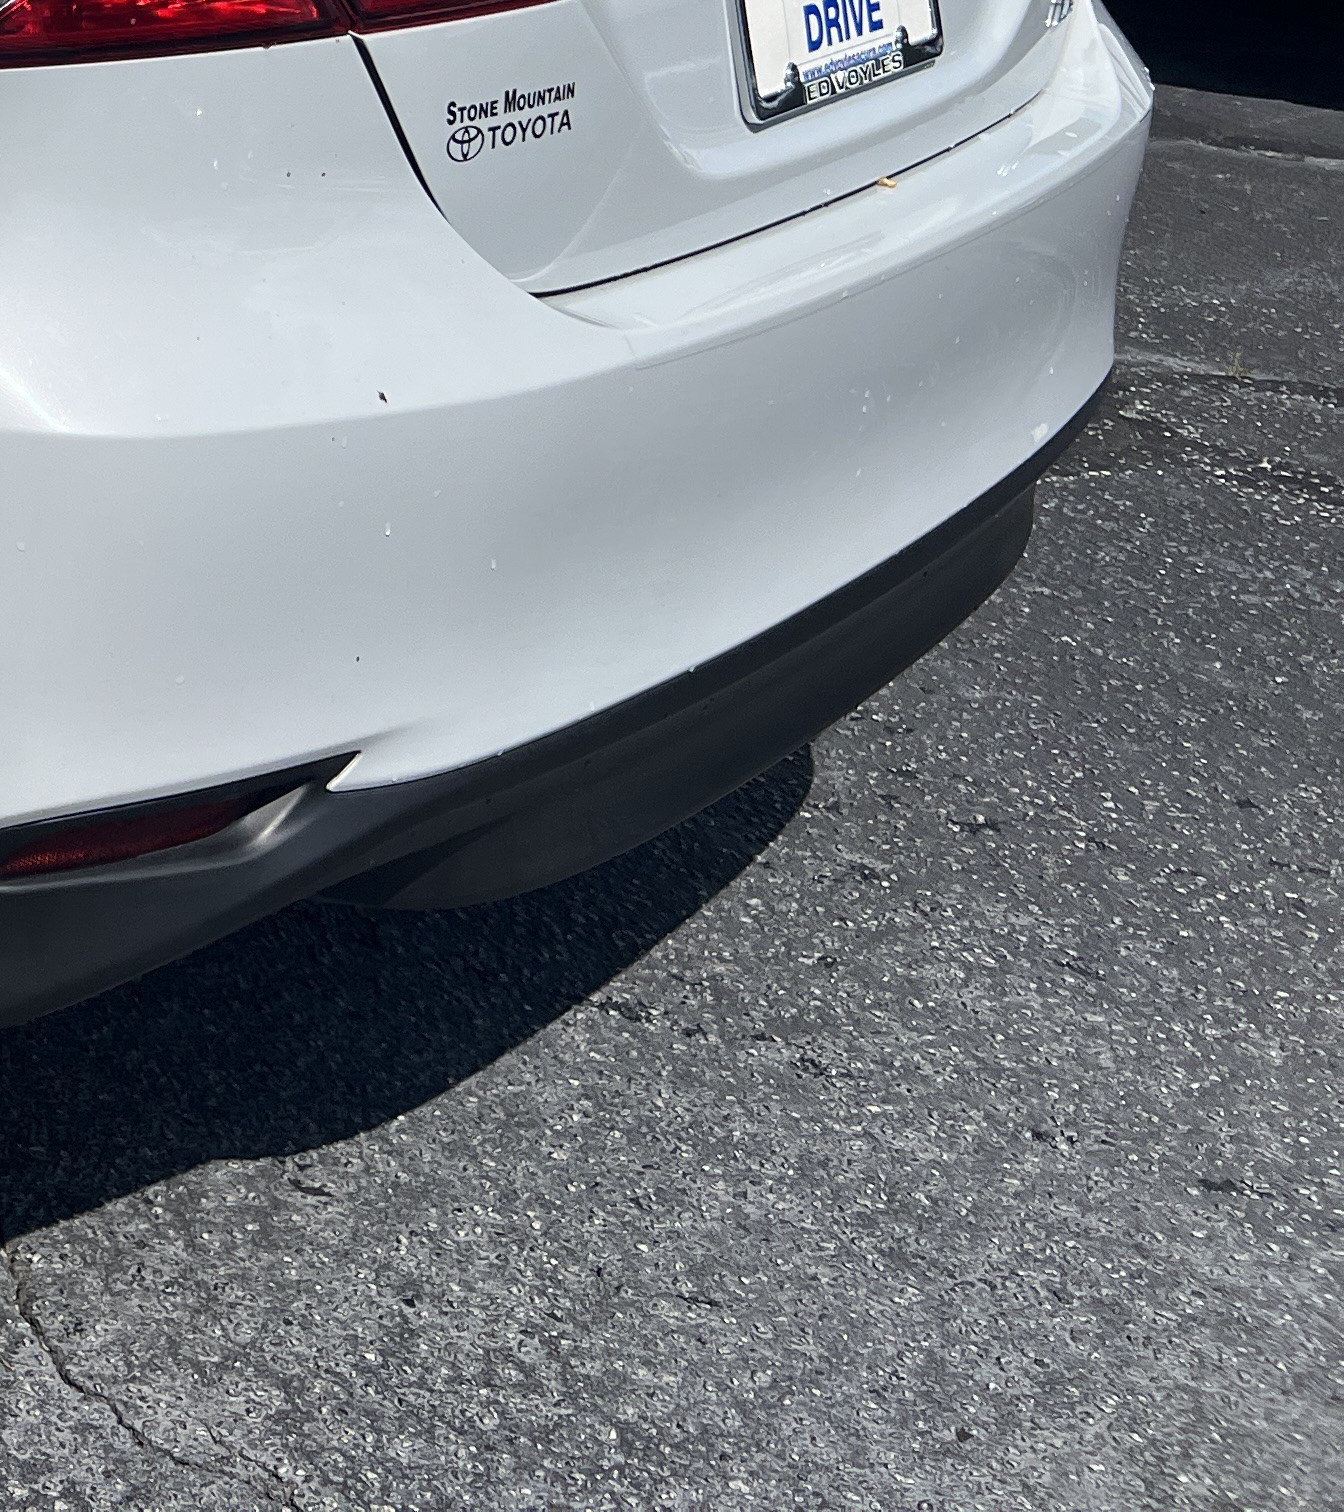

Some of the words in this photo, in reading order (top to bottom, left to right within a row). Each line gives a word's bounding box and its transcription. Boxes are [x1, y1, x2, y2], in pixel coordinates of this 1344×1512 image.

[807, 78, 831, 101] ED
[835, 53, 903, 90] VOYLES
[487, 109, 572, 150] TOYOTA
